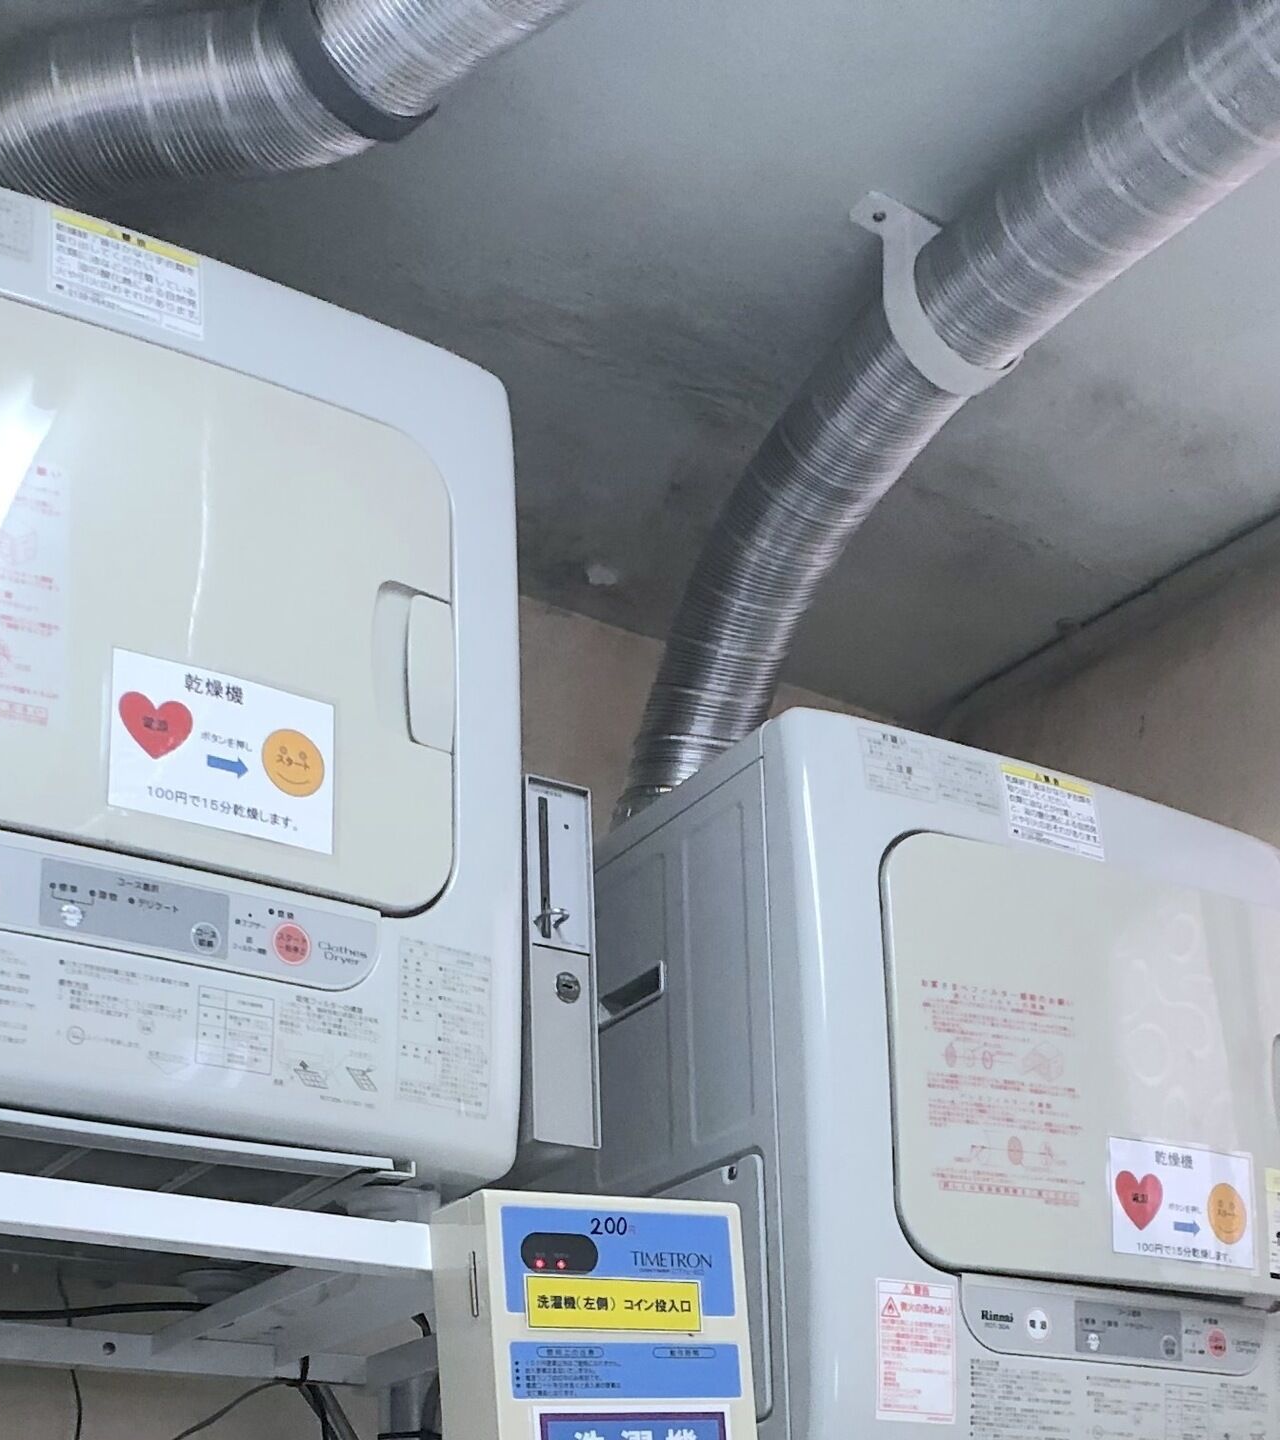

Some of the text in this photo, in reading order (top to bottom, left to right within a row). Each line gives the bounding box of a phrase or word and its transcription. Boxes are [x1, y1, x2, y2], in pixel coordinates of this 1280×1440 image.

[184, 673, 244, 705] 乾燥機
[201, 731, 253, 752] ボタンを押し
[276, 755, 311, 771] スタート
[147, 785, 298, 831] 100円で15分乾燥します。
[318, 941, 368, 959] Clothes
[324, 951, 360, 965] Dryer
[1155, 1150, 1194, 1170] 乾燥機
[590, 1217, 628, 1236] 200
[631, 1251, 713, 1269] TIMETRON
[1136, 1242, 1233, 1263] 100円で15分乾燥します。
[624, 1298, 692, 1313] コイン投入口
[981, 1310, 1014, 1322] Rinnai
